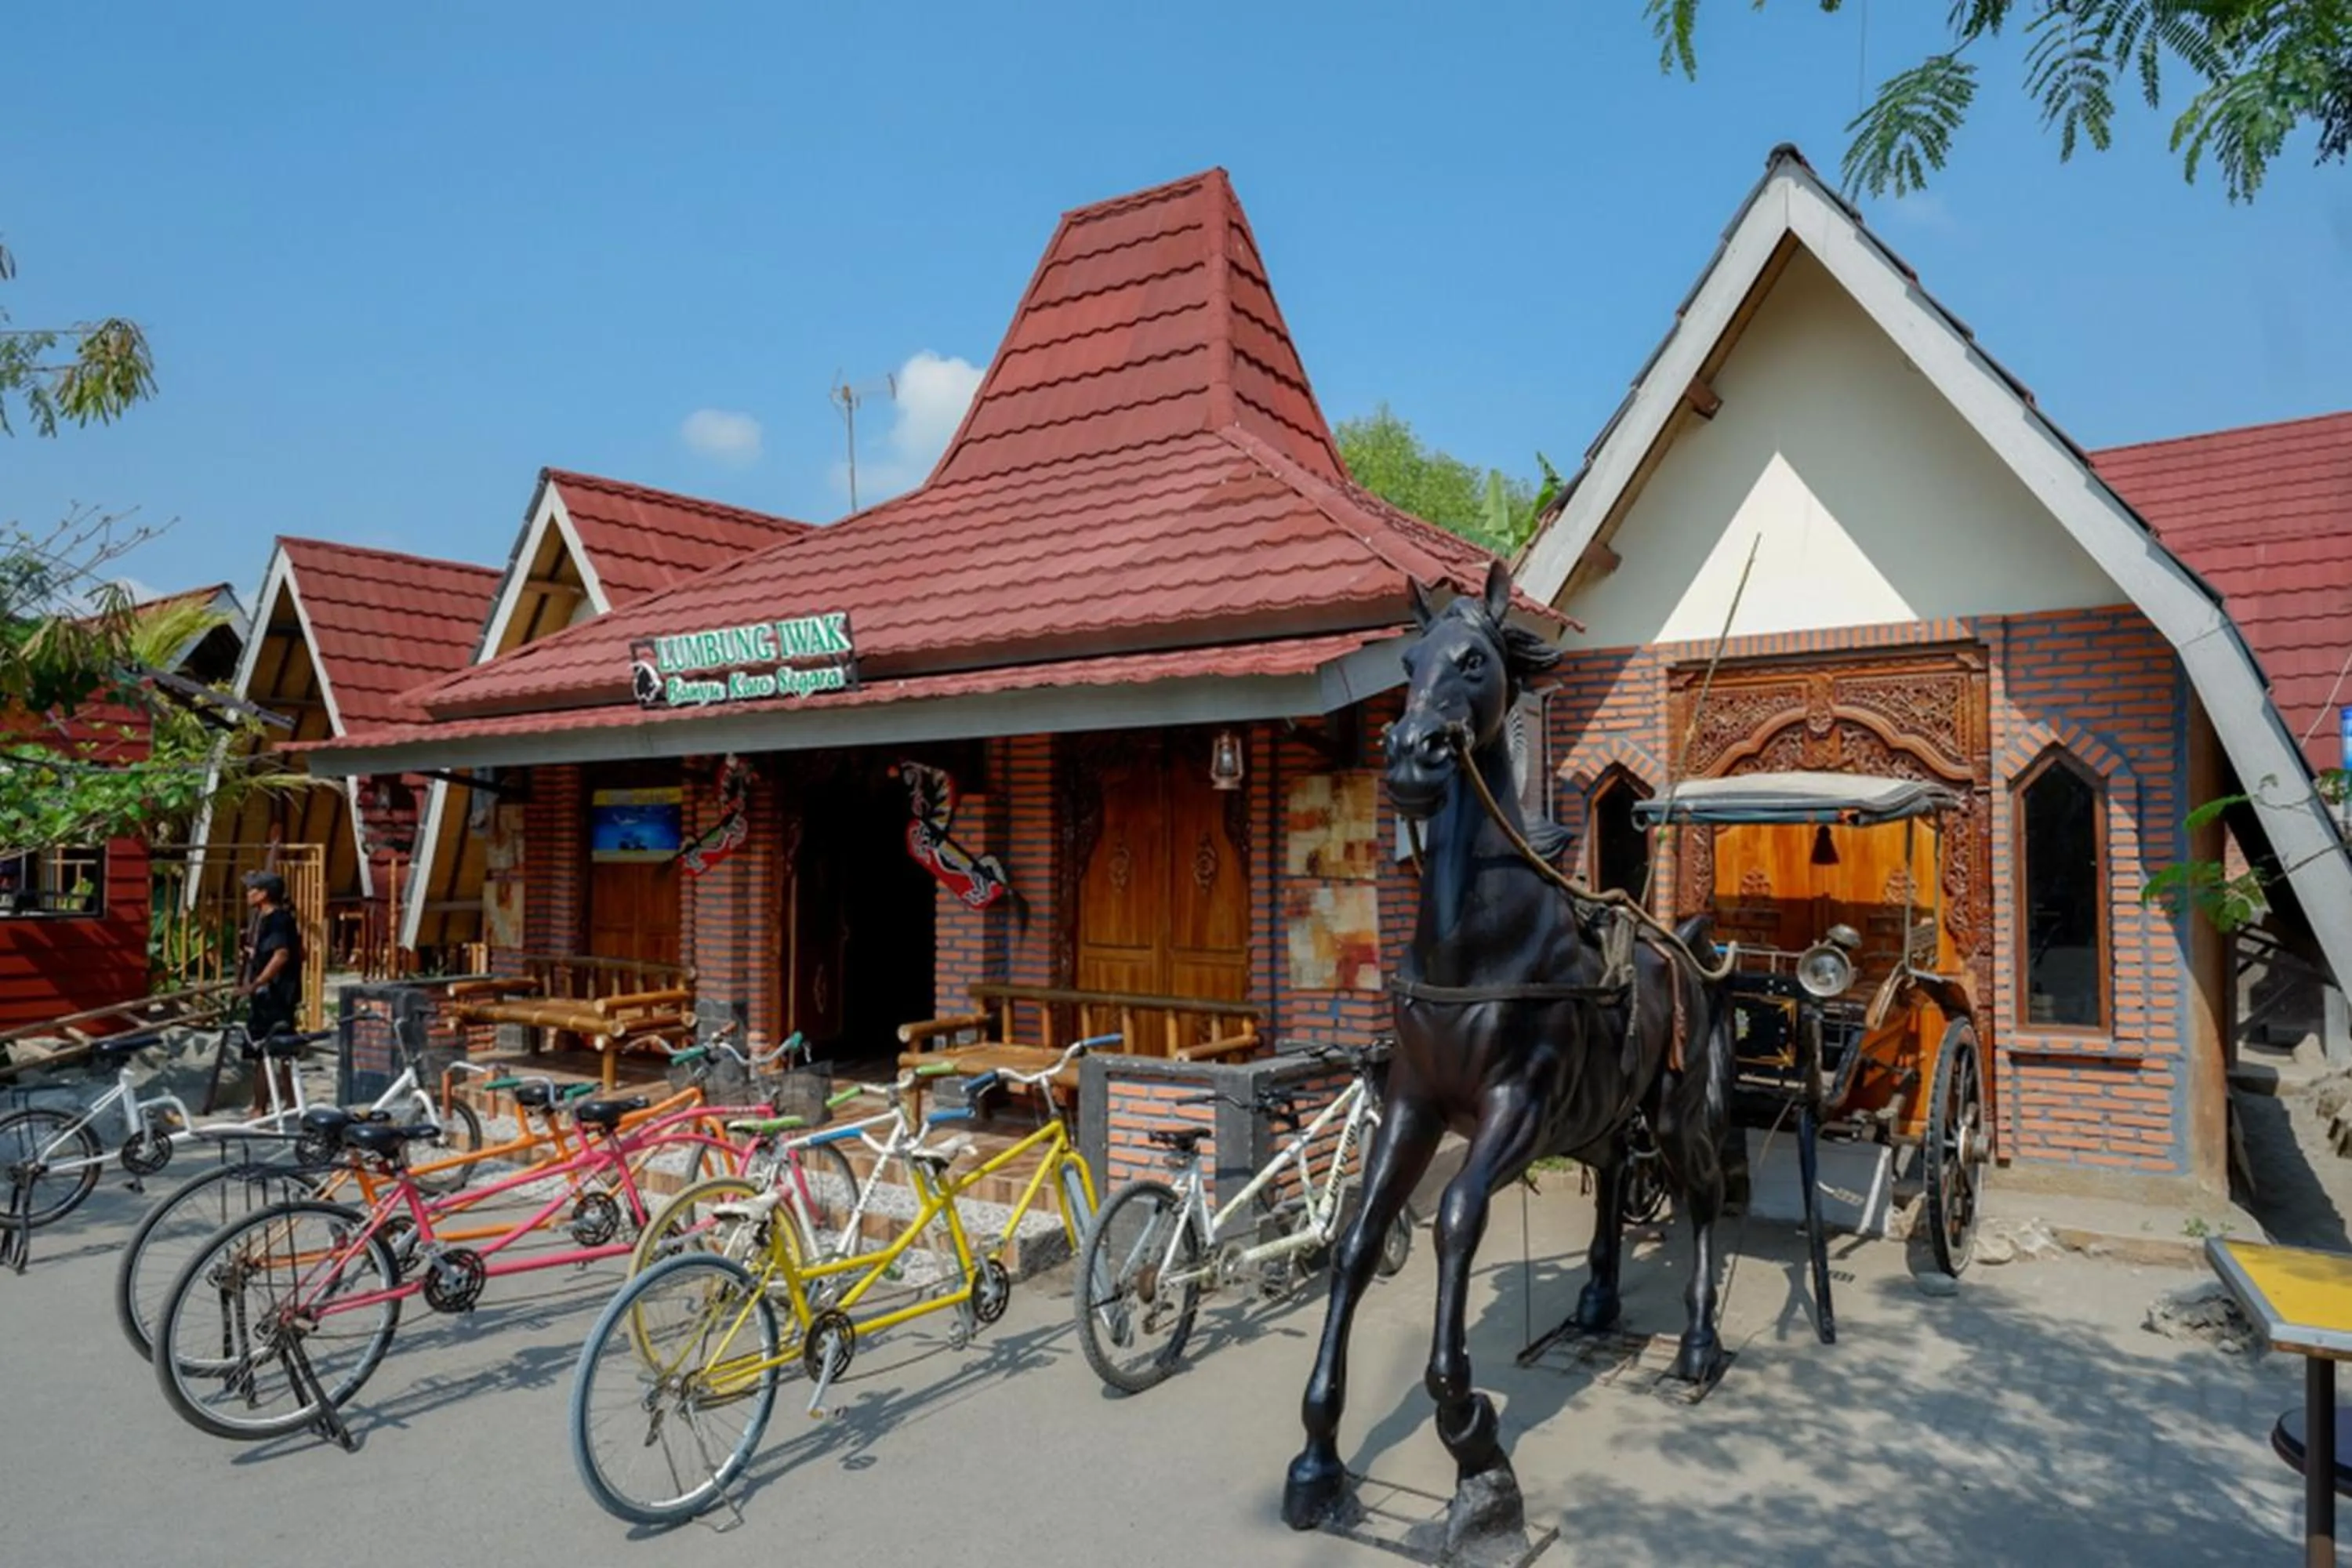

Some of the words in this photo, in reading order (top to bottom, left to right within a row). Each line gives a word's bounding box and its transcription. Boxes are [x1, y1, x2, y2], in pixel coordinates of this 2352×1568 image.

[655, 623, 777, 673] LUMBUNG
[776, 612, 852, 658] IWAK
[776, 666, 845, 699] Segara
